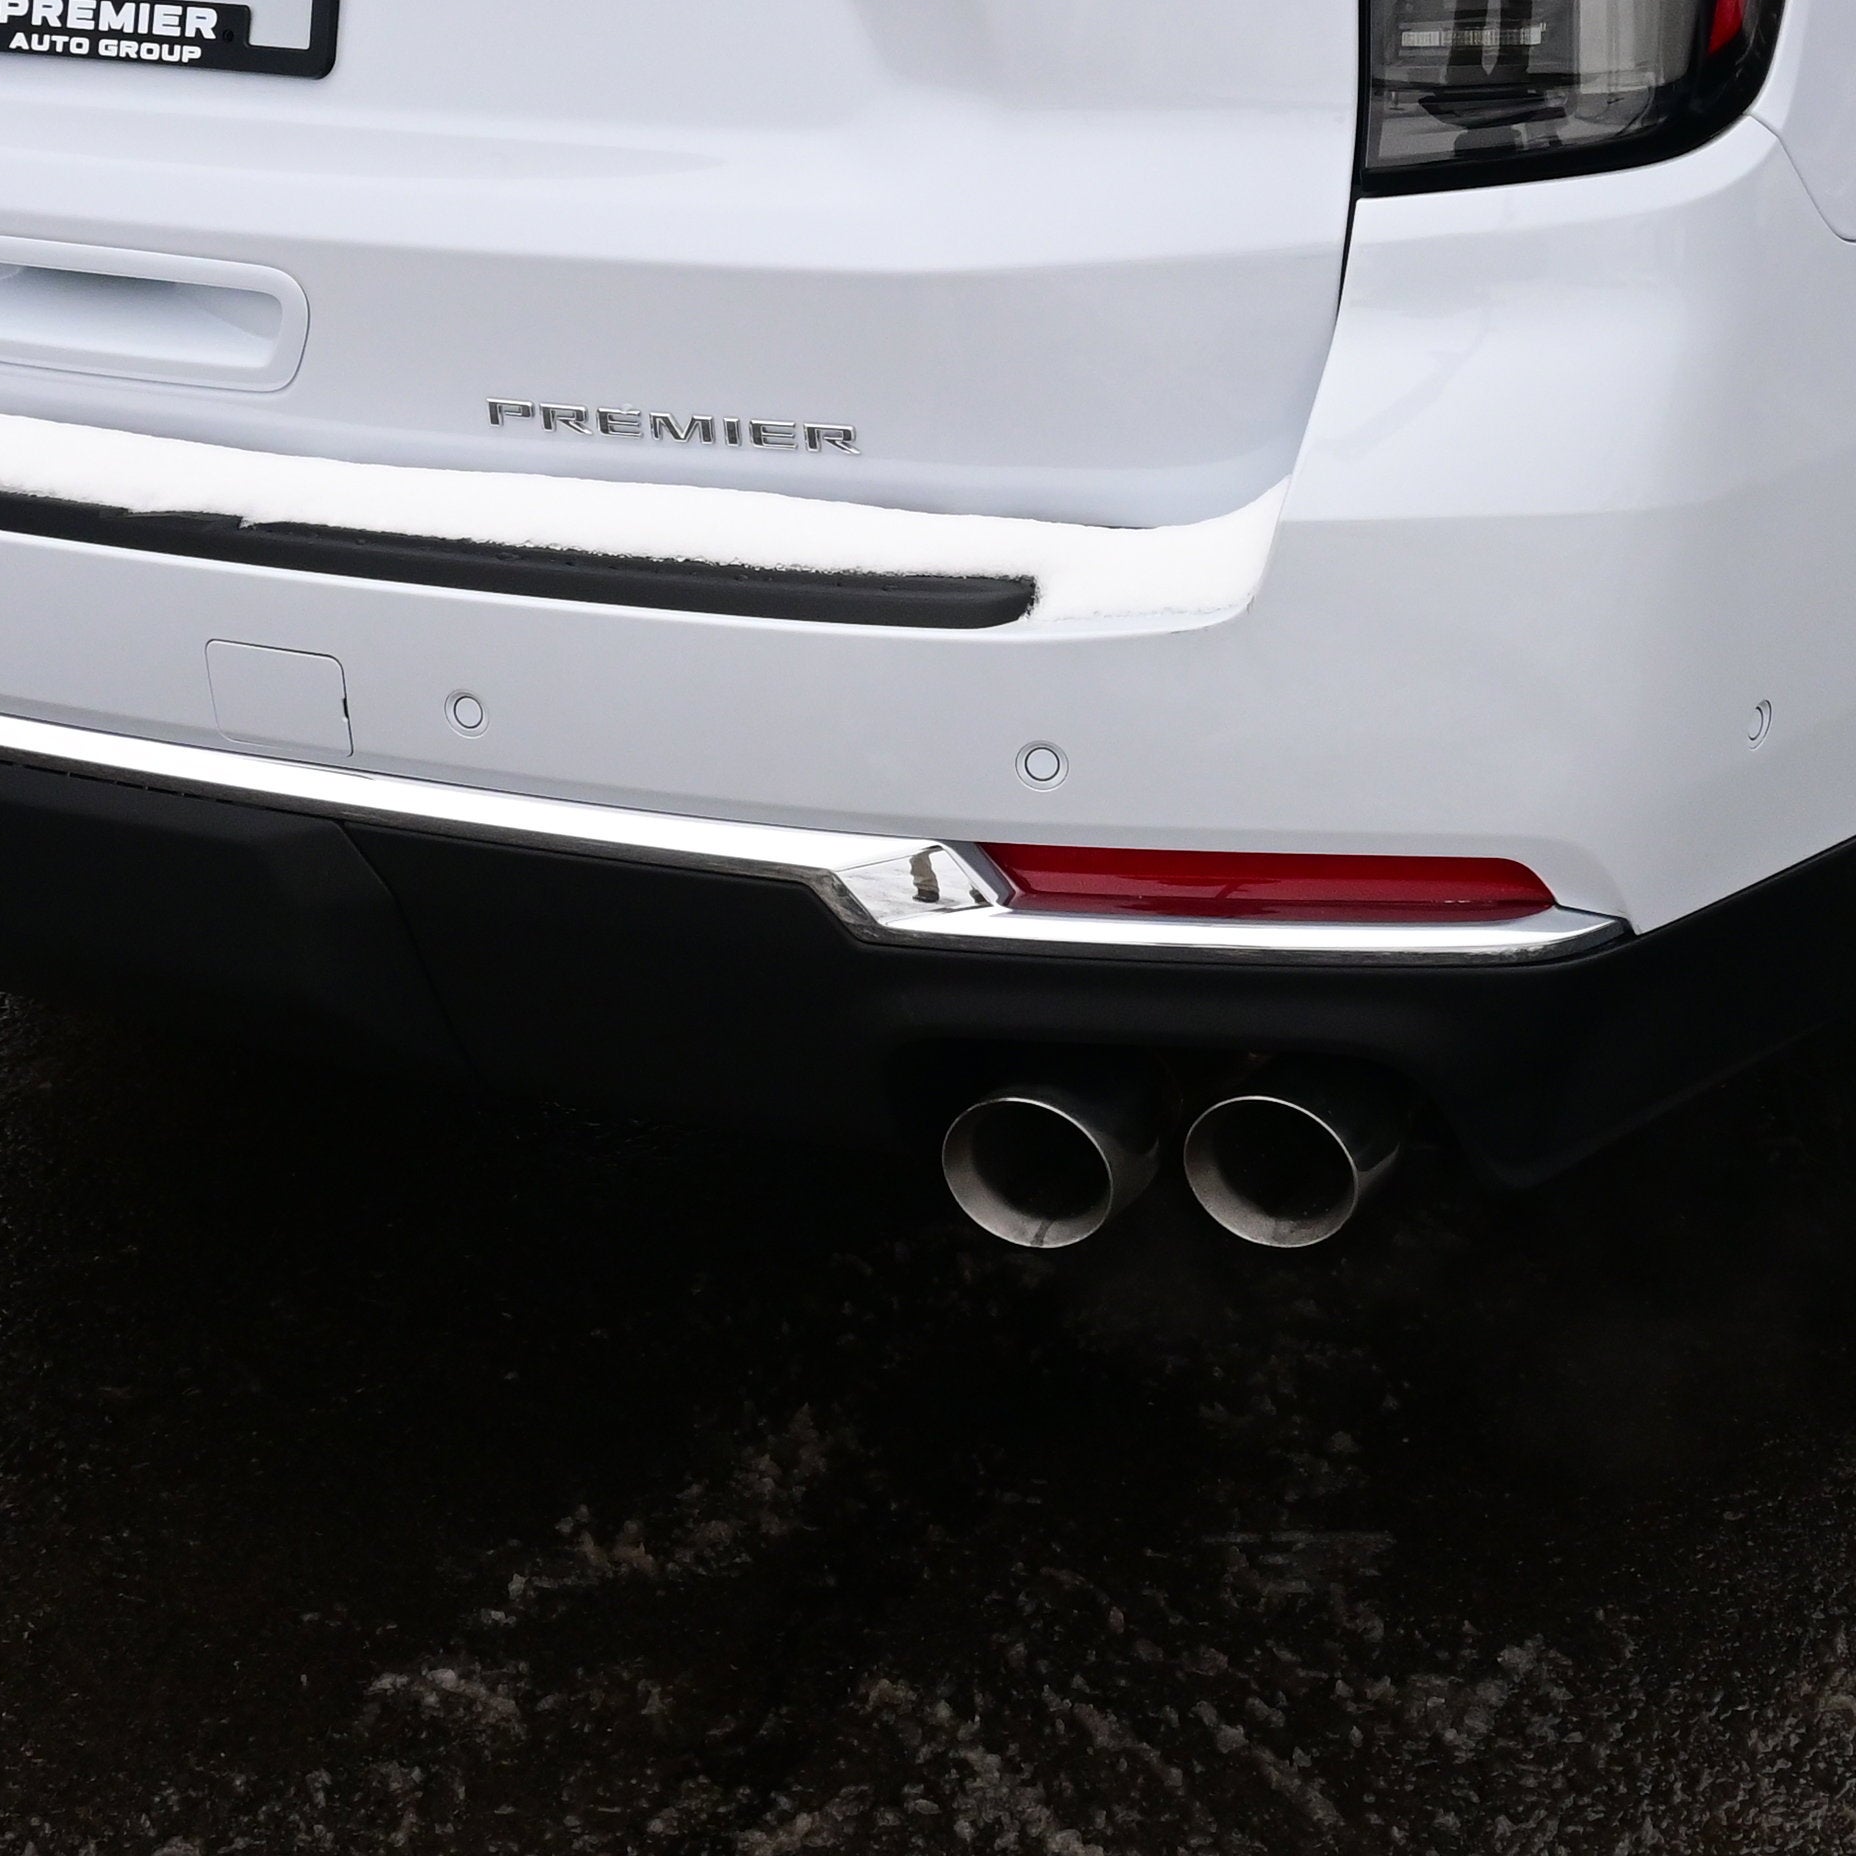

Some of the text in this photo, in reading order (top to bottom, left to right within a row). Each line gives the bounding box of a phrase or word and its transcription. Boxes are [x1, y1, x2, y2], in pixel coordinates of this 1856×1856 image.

[9, 31, 203, 64] AUTO GROUP
[484, 396, 862, 456] PREMIER
